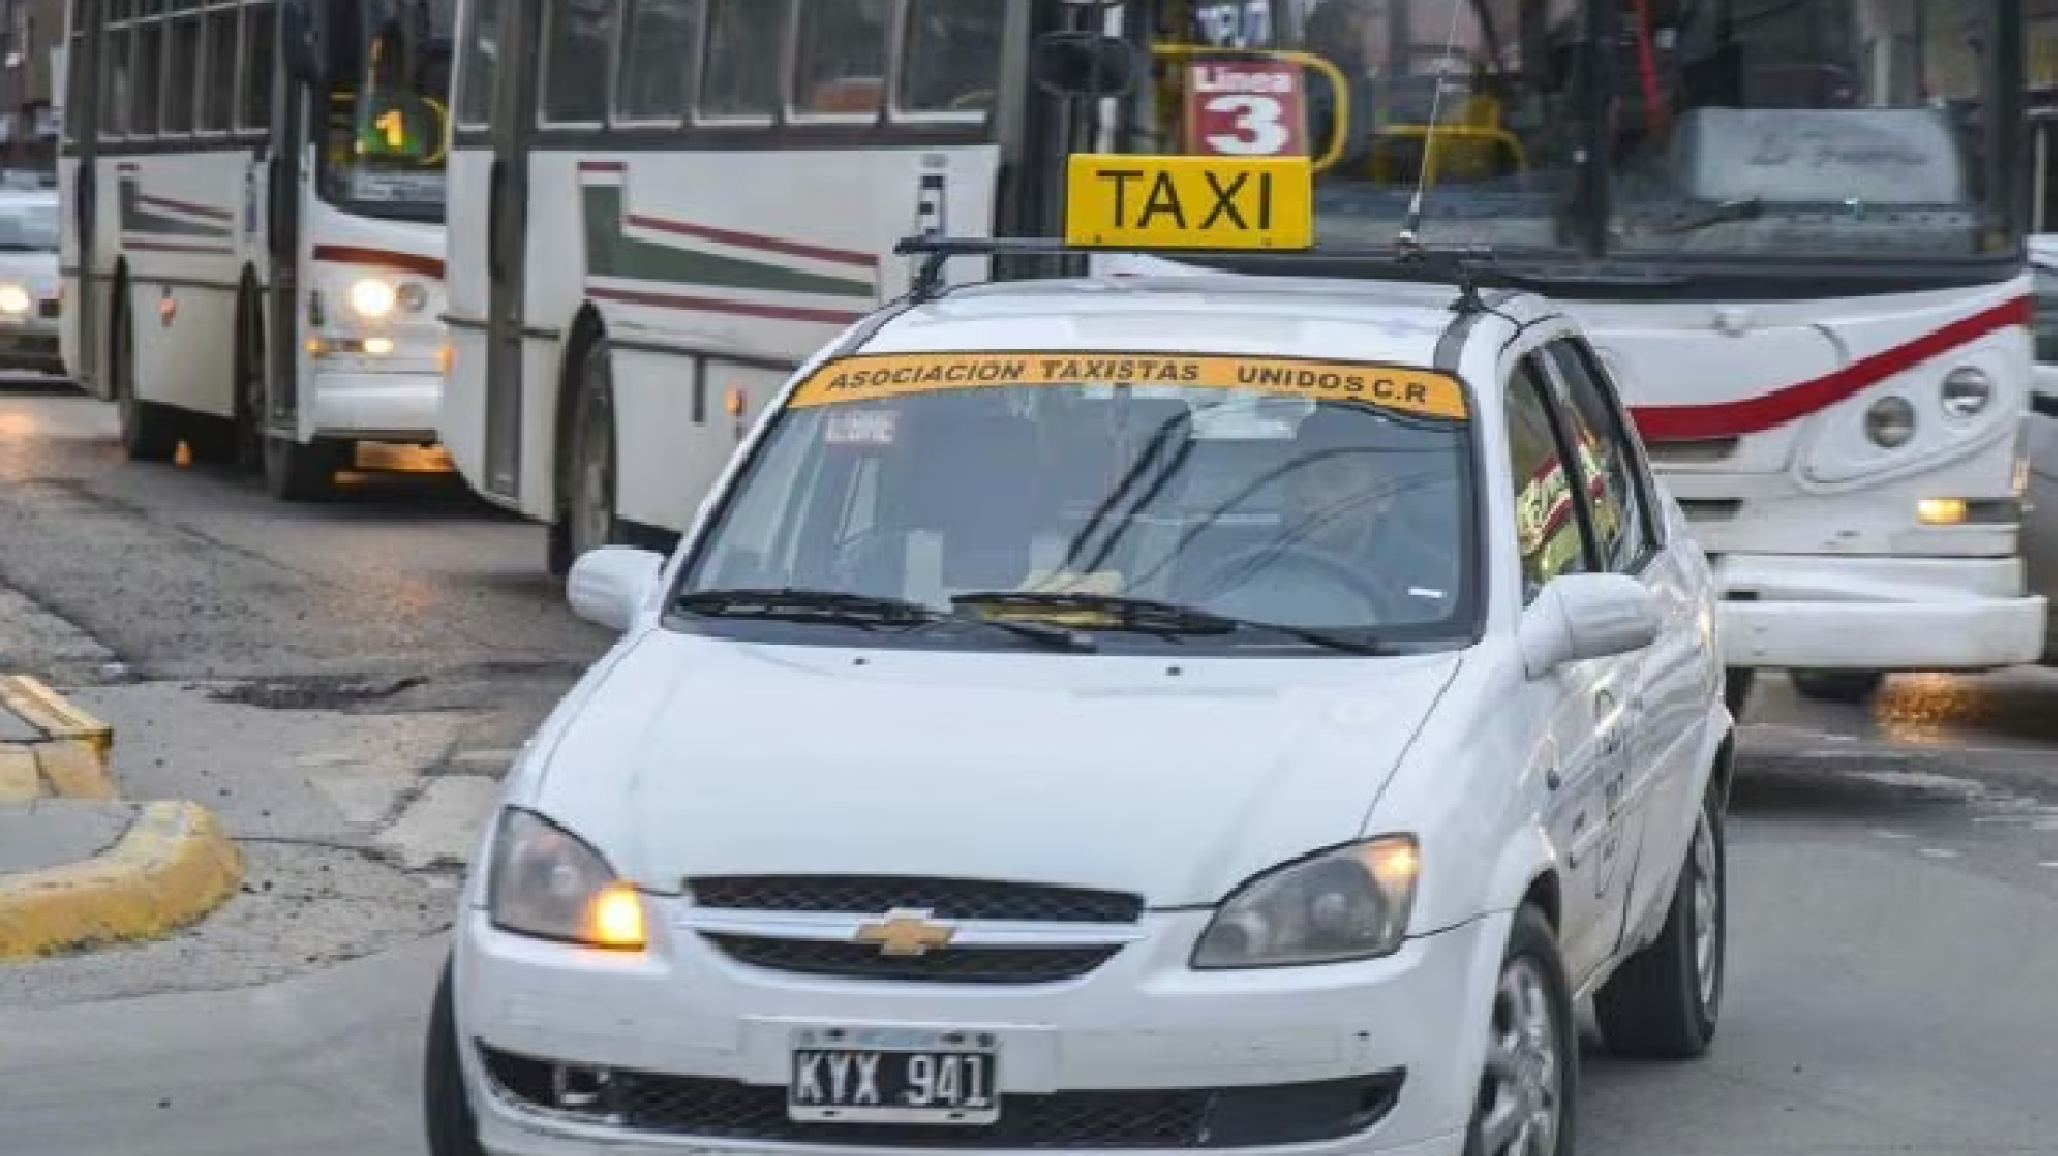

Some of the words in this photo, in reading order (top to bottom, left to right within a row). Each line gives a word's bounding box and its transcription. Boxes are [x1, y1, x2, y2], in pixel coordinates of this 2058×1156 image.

[374, 108, 402, 146] 1
[1204, 94, 1289, 156] 3
[1096, 169, 1272, 229] TAXI
[826, 364, 1025, 391] ASOCIACION
[1040, 359, 1201, 381] TAXISTAS
[1237, 365, 1365, 393] UNIDOS
[797, 1053, 882, 1104] KYX
[904, 1054, 988, 1107] 941
